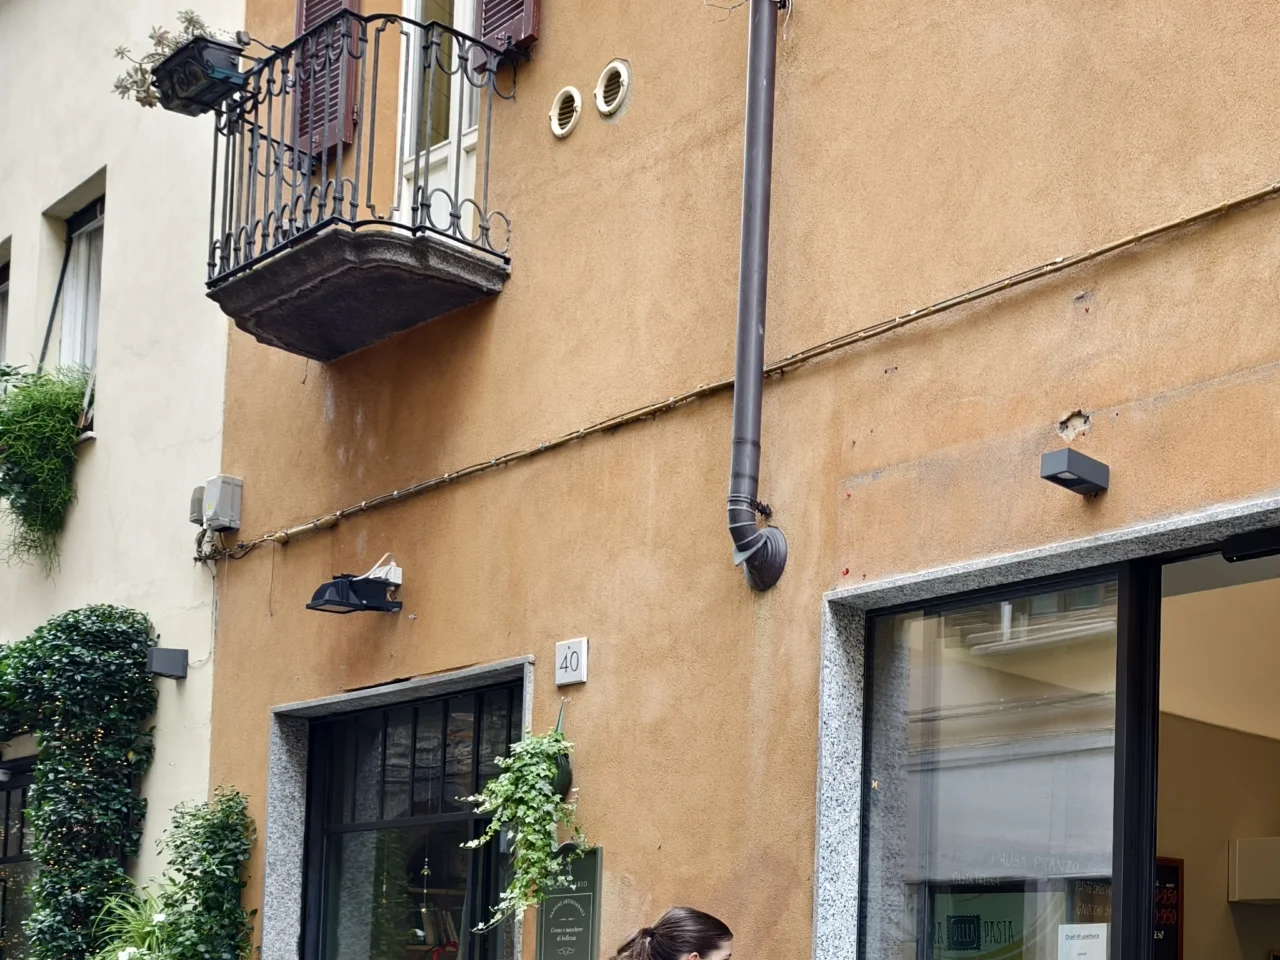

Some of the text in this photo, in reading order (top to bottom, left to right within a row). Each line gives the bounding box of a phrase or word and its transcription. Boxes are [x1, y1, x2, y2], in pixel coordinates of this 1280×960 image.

[559, 650, 580, 673] 40
[1033, 857, 1080, 874] PRANZO
[984, 920, 1015, 944] PASTA
